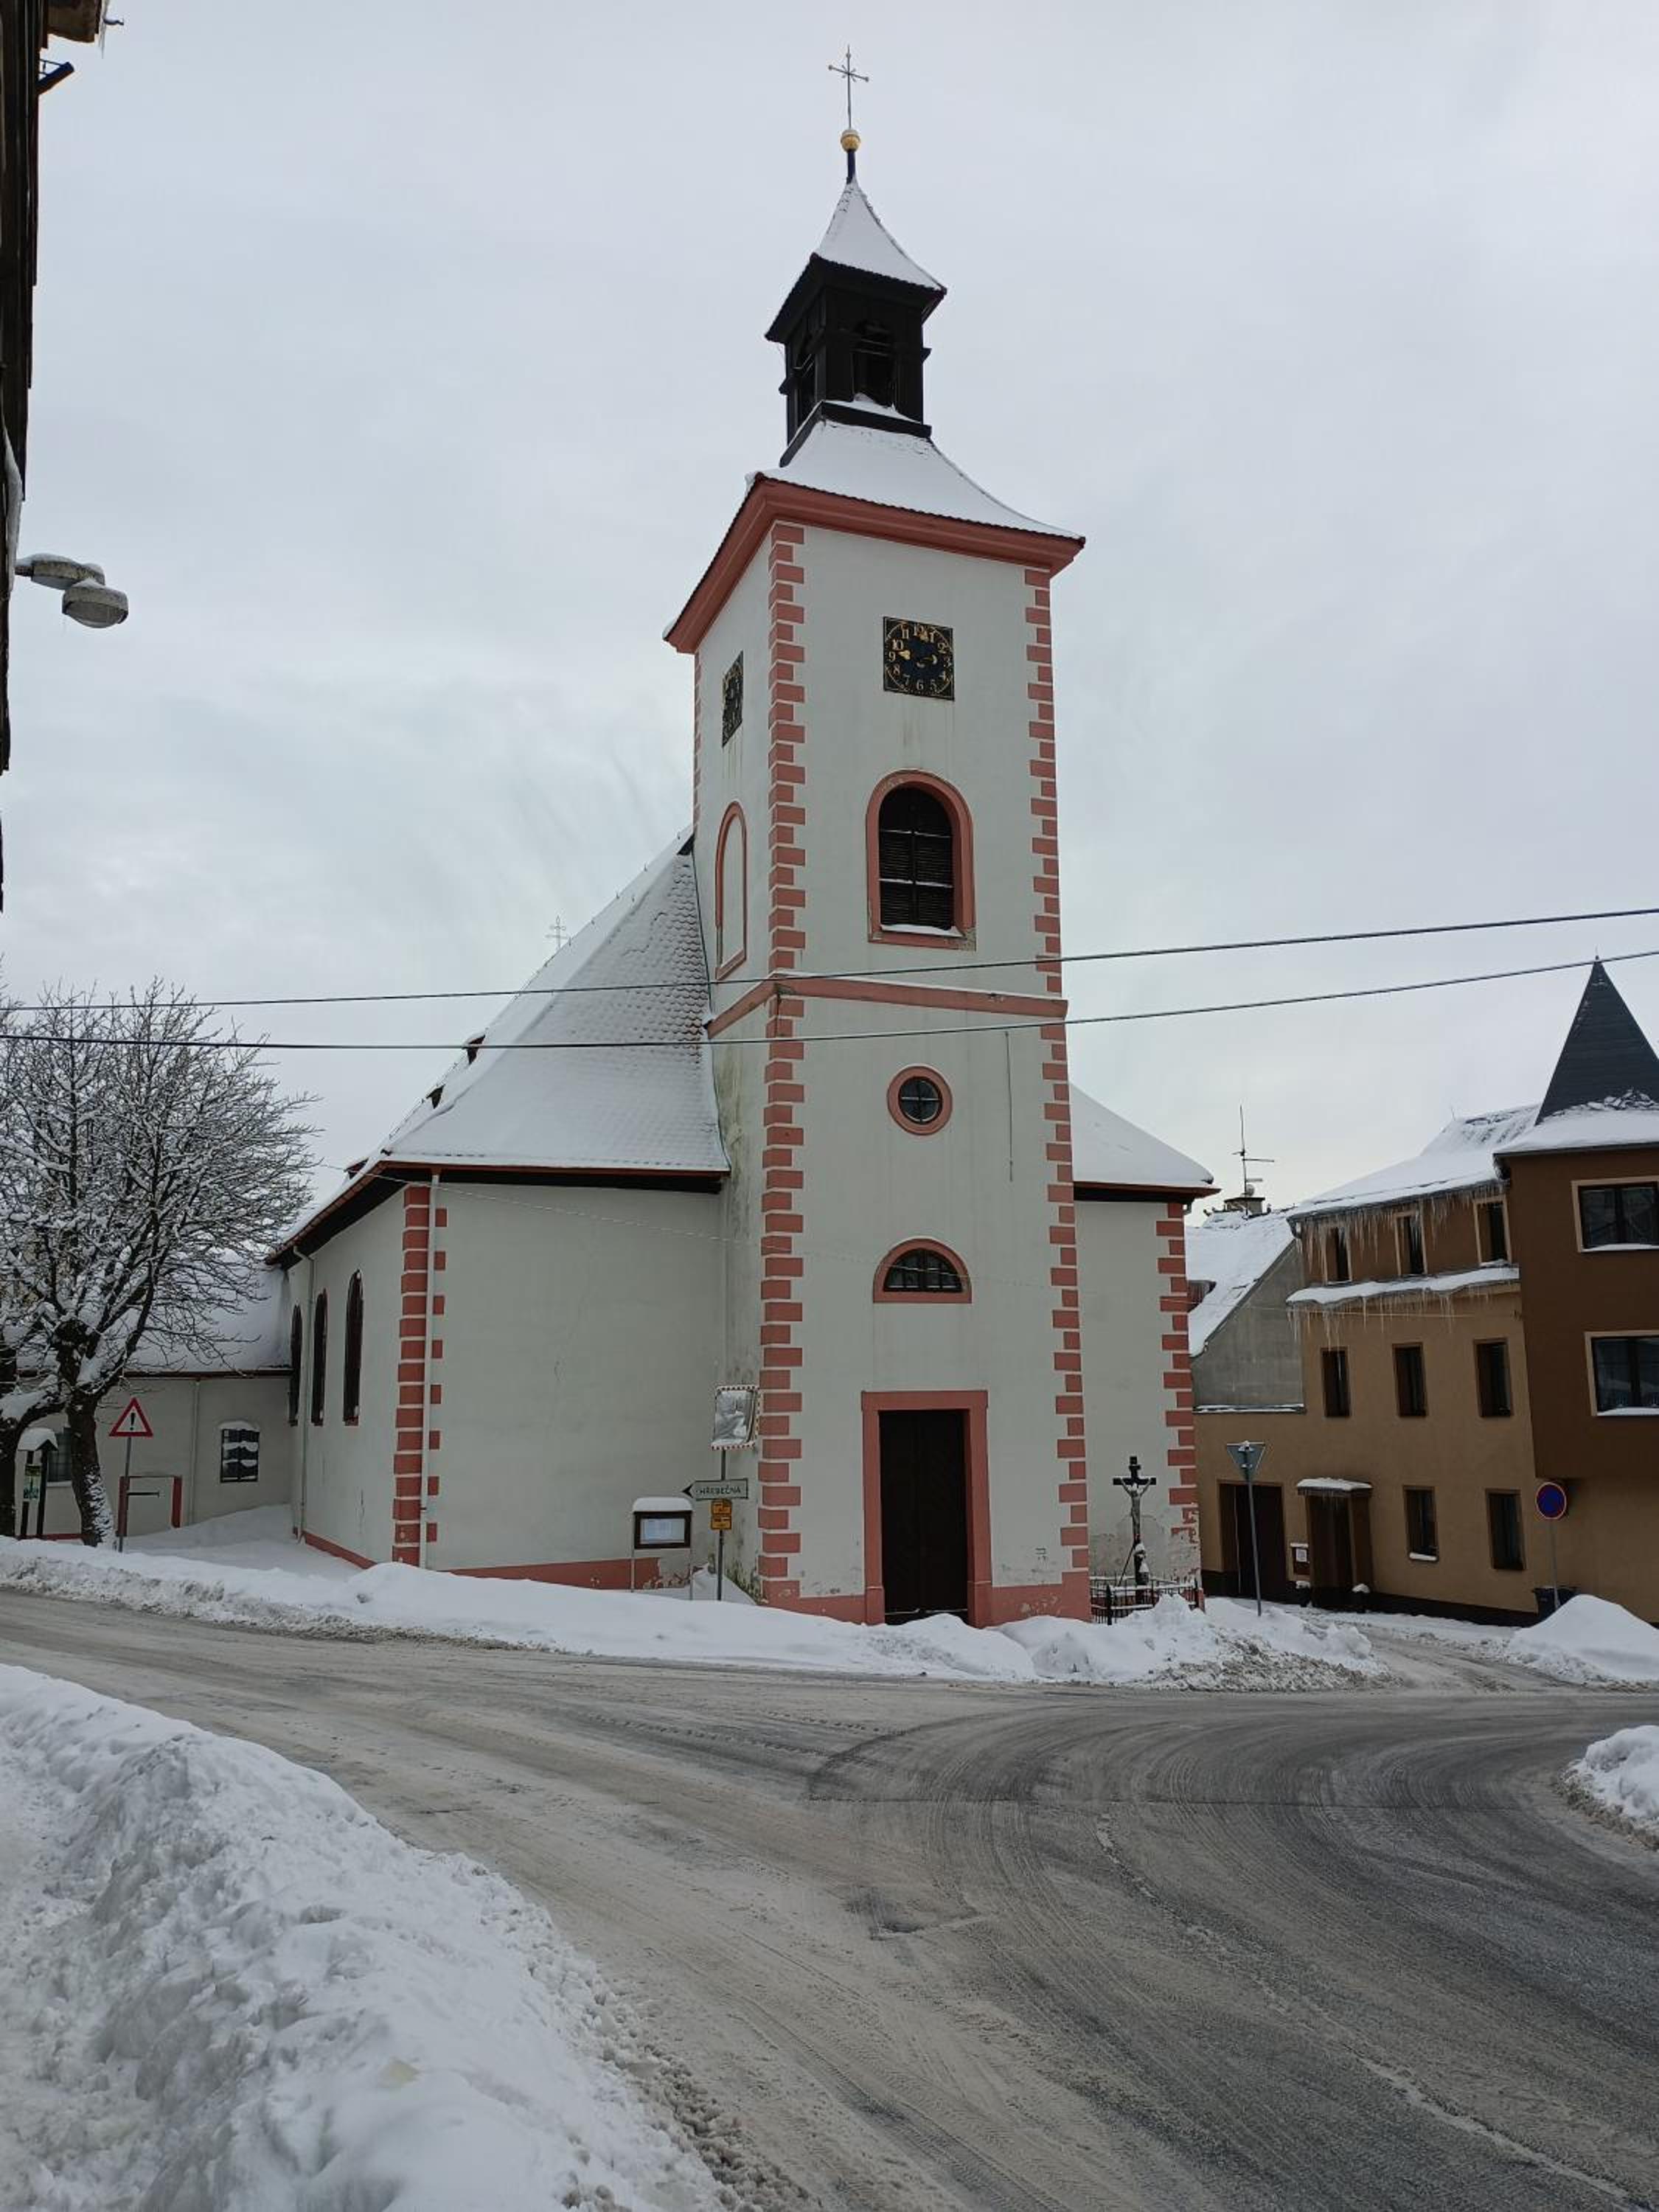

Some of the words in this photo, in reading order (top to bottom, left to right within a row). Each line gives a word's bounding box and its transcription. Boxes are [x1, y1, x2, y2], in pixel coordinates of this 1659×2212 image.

[902, 629, 909, 639] 11
[929, 632, 935, 643] 1
[892, 639, 903, 650] 10
[937, 642, 946, 654] 2
[888, 651, 896, 662] 9
[893, 664, 900, 676] 8
[903, 674, 911, 686] 7
[917, 679, 924, 691] 6
[931, 679, 938, 692] 5
